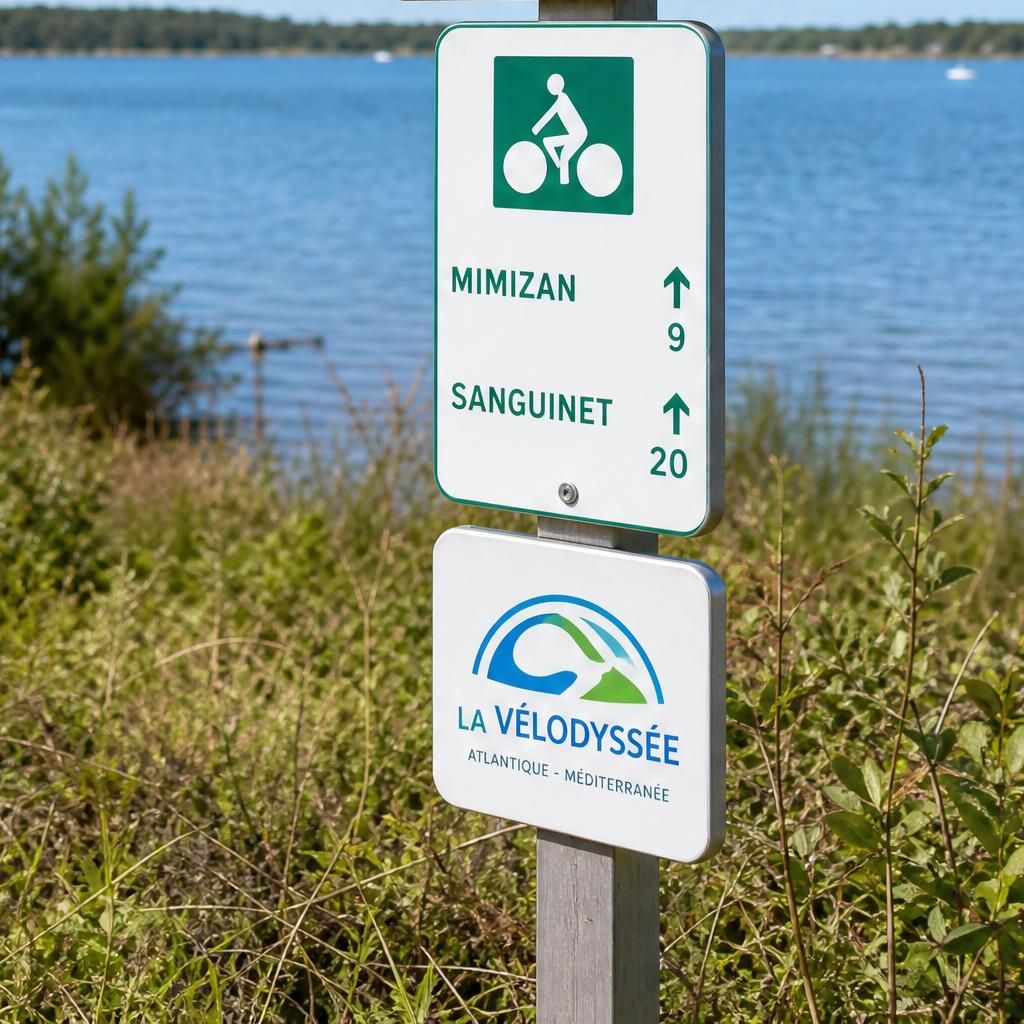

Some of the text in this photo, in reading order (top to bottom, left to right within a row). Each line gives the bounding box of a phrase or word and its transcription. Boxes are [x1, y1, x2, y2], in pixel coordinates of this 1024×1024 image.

[451, 266, 576, 303] MIMIZAN
[667, 322, 686, 353] 9
[451, 382, 613, 427] SANGUINET
[650, 446, 688, 479] 20
[458, 702, 680, 766] LA VÉLODYSSÉE
[467, 748, 549, 777] ATLANTIQUE
[564, 768, 670, 803] MÉDITERRANÉE
